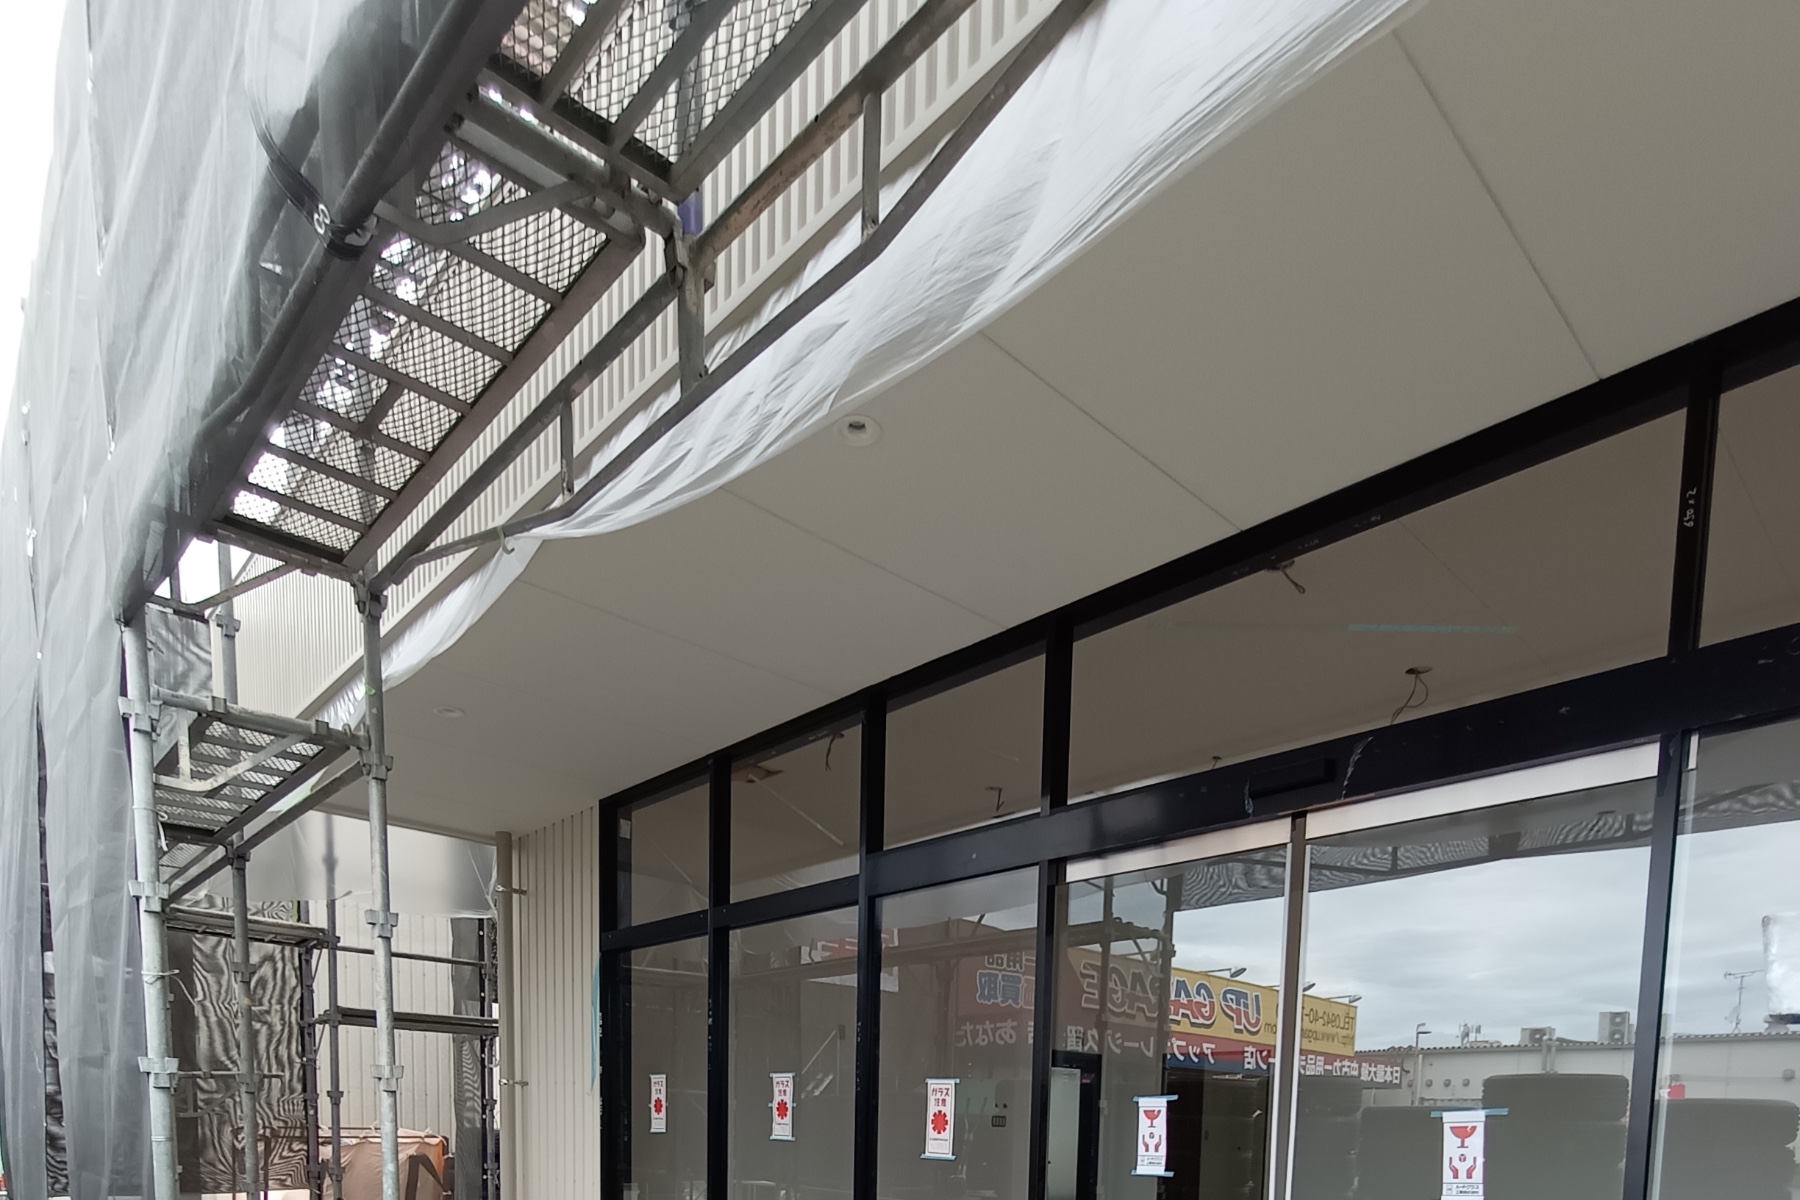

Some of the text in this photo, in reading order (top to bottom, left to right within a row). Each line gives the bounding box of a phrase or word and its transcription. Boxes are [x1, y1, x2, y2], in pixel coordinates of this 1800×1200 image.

[931, 1087, 950, 1097] ガラス
[934, 1097, 947, 1107] 注意
